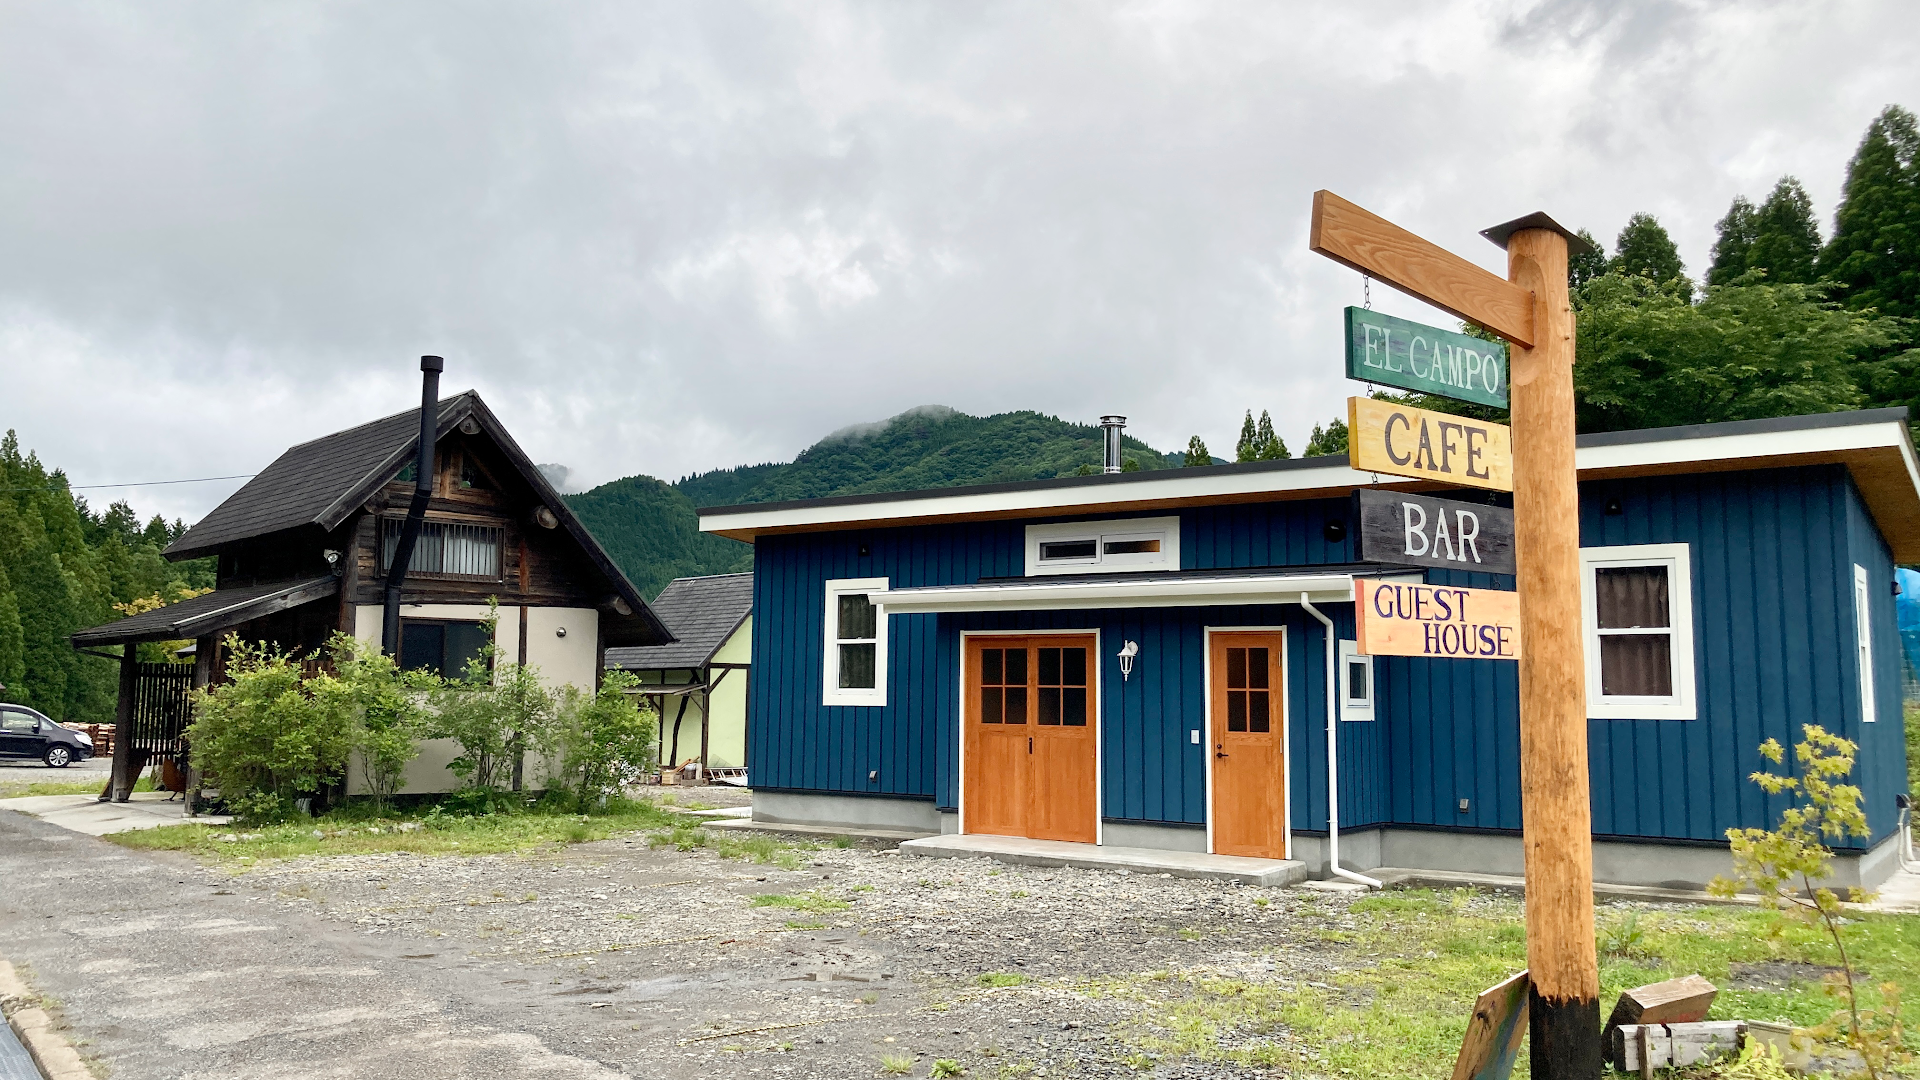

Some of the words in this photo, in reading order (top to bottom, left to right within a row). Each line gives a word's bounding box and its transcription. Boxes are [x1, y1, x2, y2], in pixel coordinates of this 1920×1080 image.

[1362, 323, 1402, 373] EL
[1409, 335, 1499, 394] CAMPO
[1384, 412, 1490, 479] CAFE
[1402, 502, 1482, 563] BAR
[1374, 584, 1470, 622] GUEST
[1423, 622, 1514, 656] HOUSE
